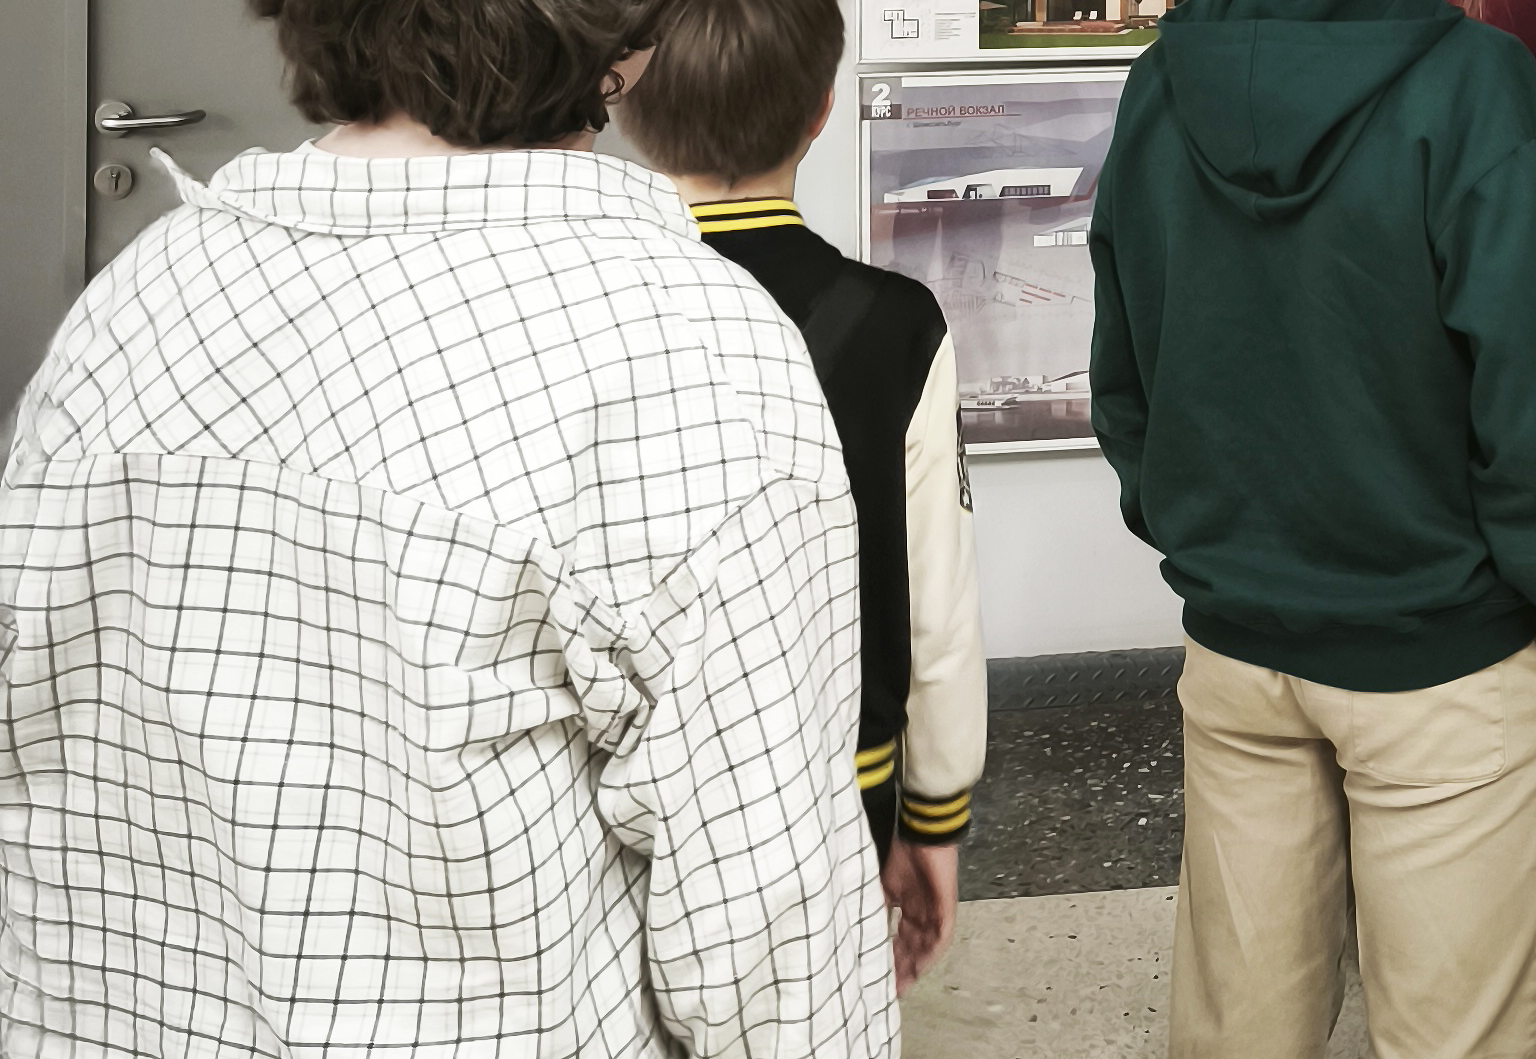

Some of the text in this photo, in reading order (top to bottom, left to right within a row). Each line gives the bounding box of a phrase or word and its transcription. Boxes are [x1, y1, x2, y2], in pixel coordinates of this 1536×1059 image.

[871, 83, 891, 106] 2
[871, 105, 892, 118] КУРС
[906, 104, 1005, 118] РЕЧНОЙ ВОКЗАЛ
